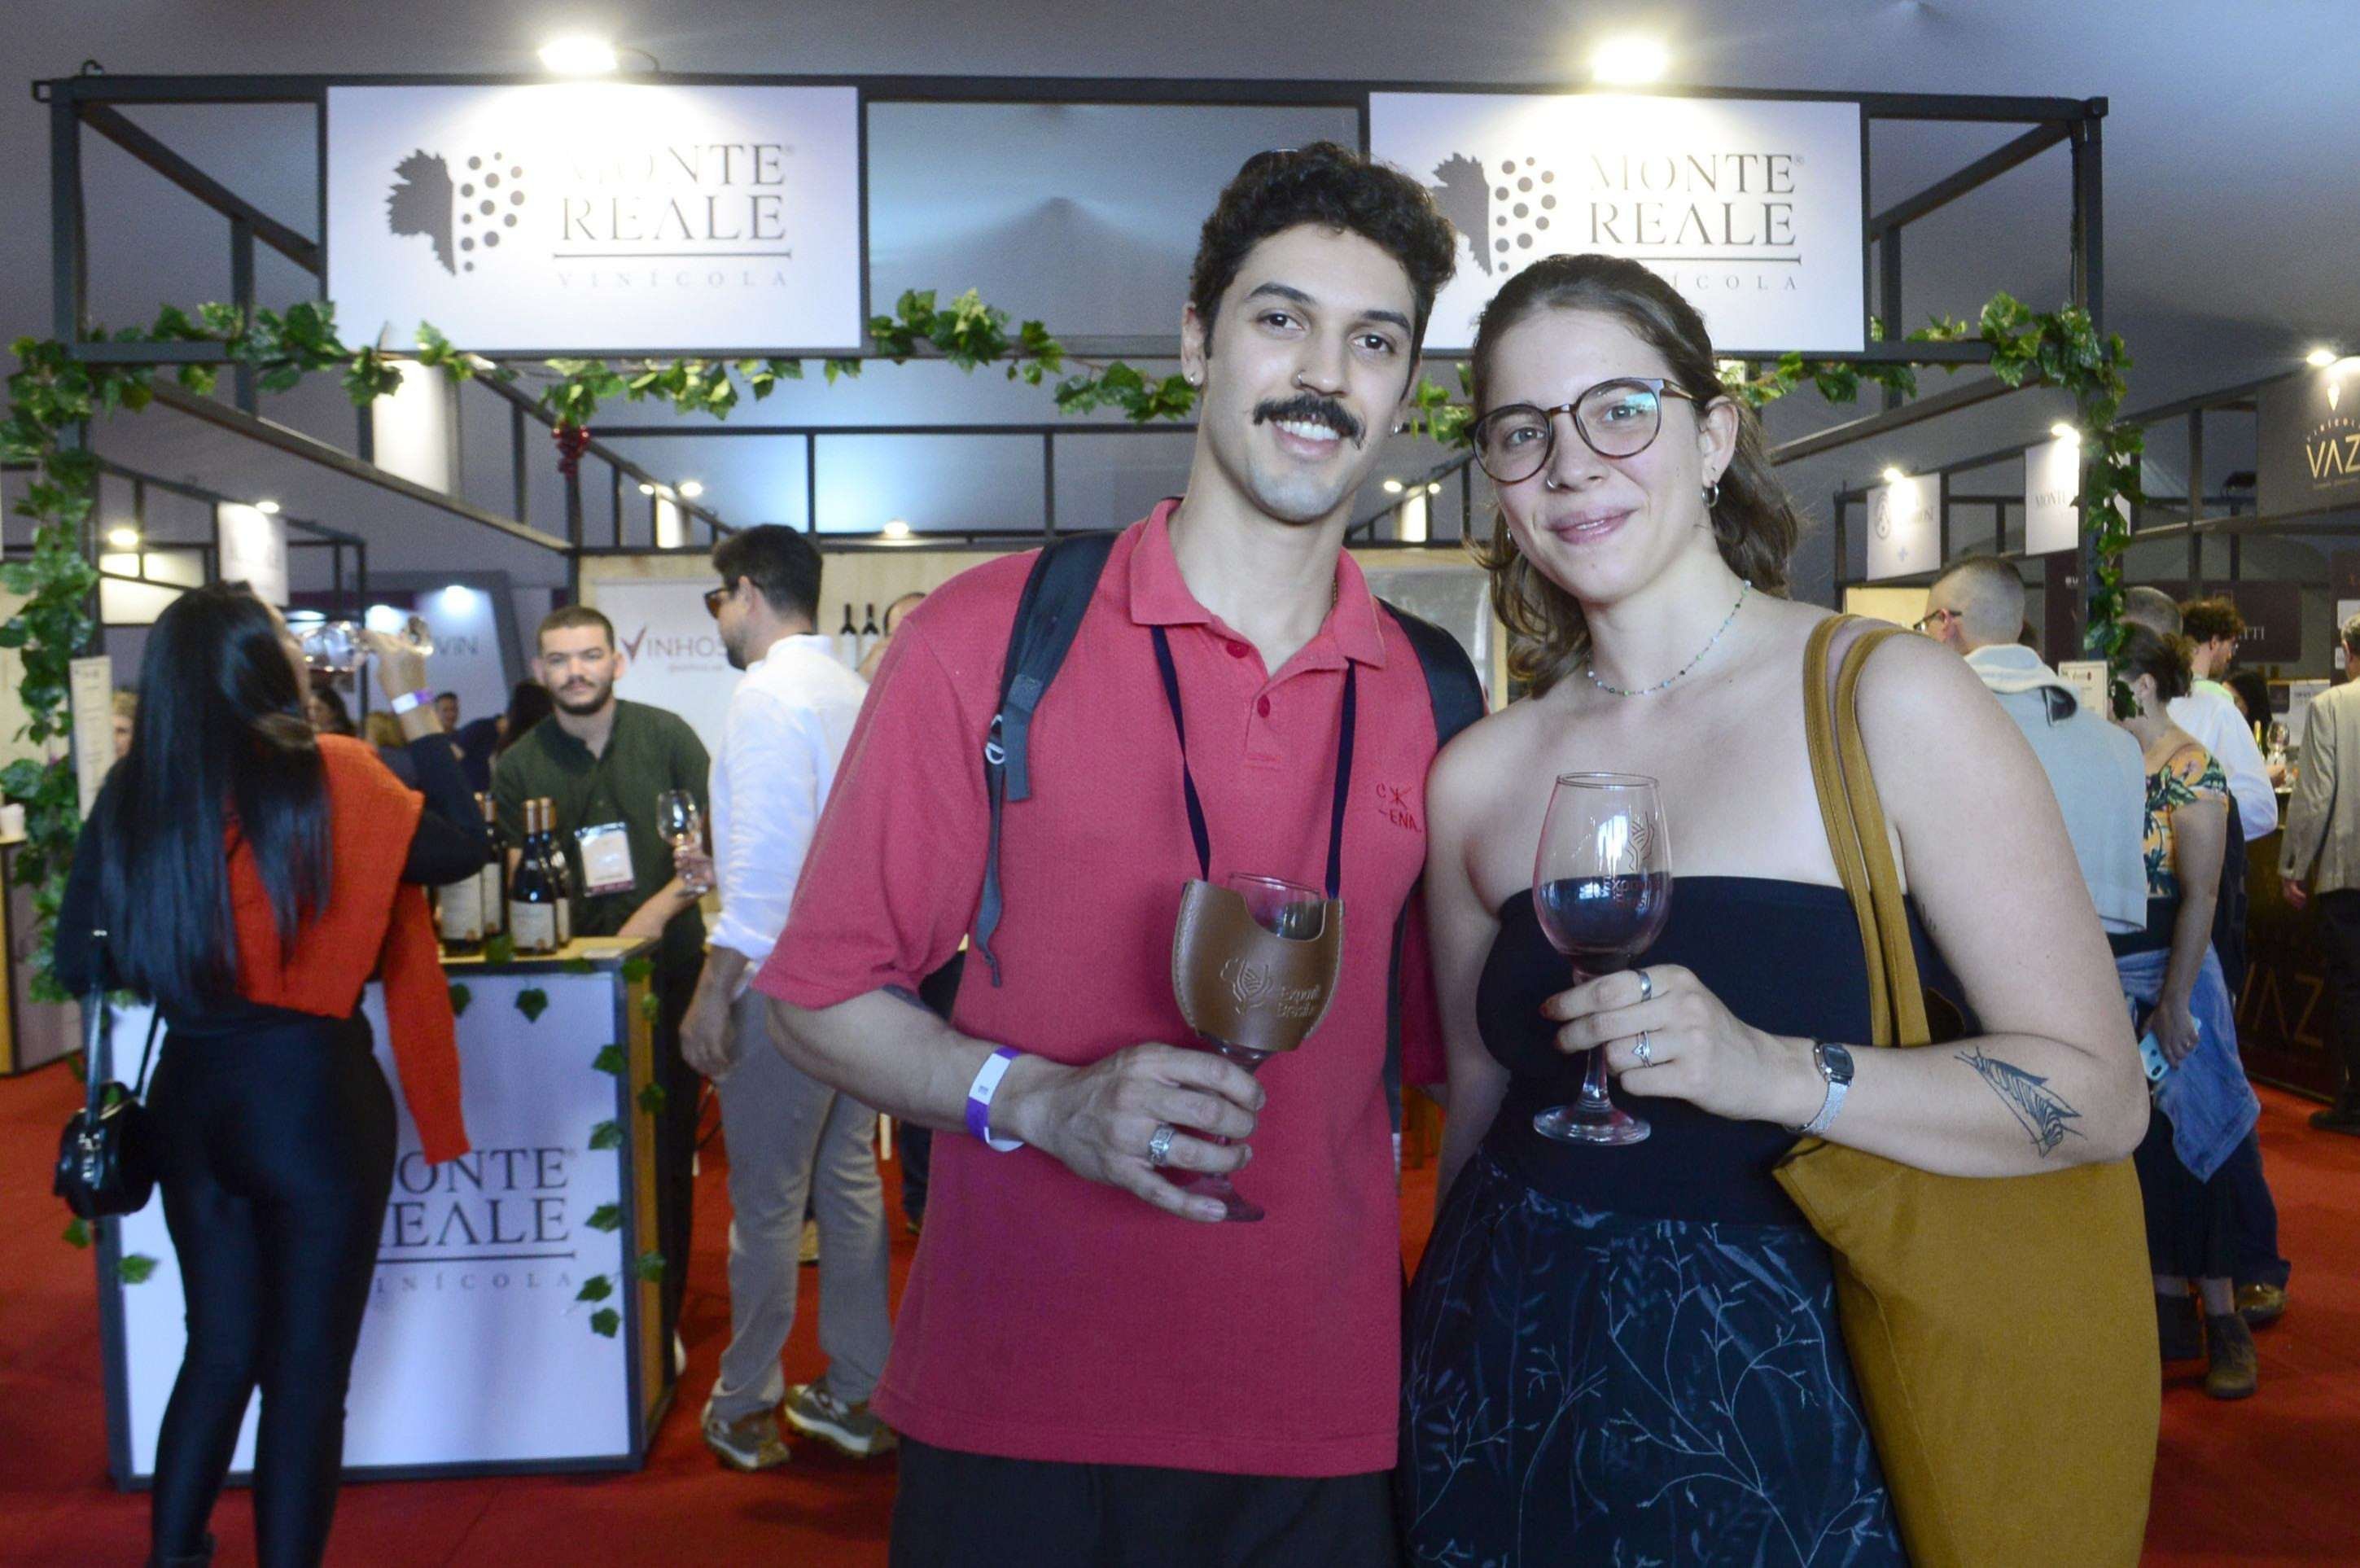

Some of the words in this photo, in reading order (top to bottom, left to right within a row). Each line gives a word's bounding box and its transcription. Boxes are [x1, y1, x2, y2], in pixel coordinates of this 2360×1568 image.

[1590, 153, 1796, 194] MONTE
[562, 195, 786, 241] REALE
[1590, 202, 1797, 246] REALE
[398, 1146, 569, 1195] ONTE
[383, 1196, 570, 1248] EALE
